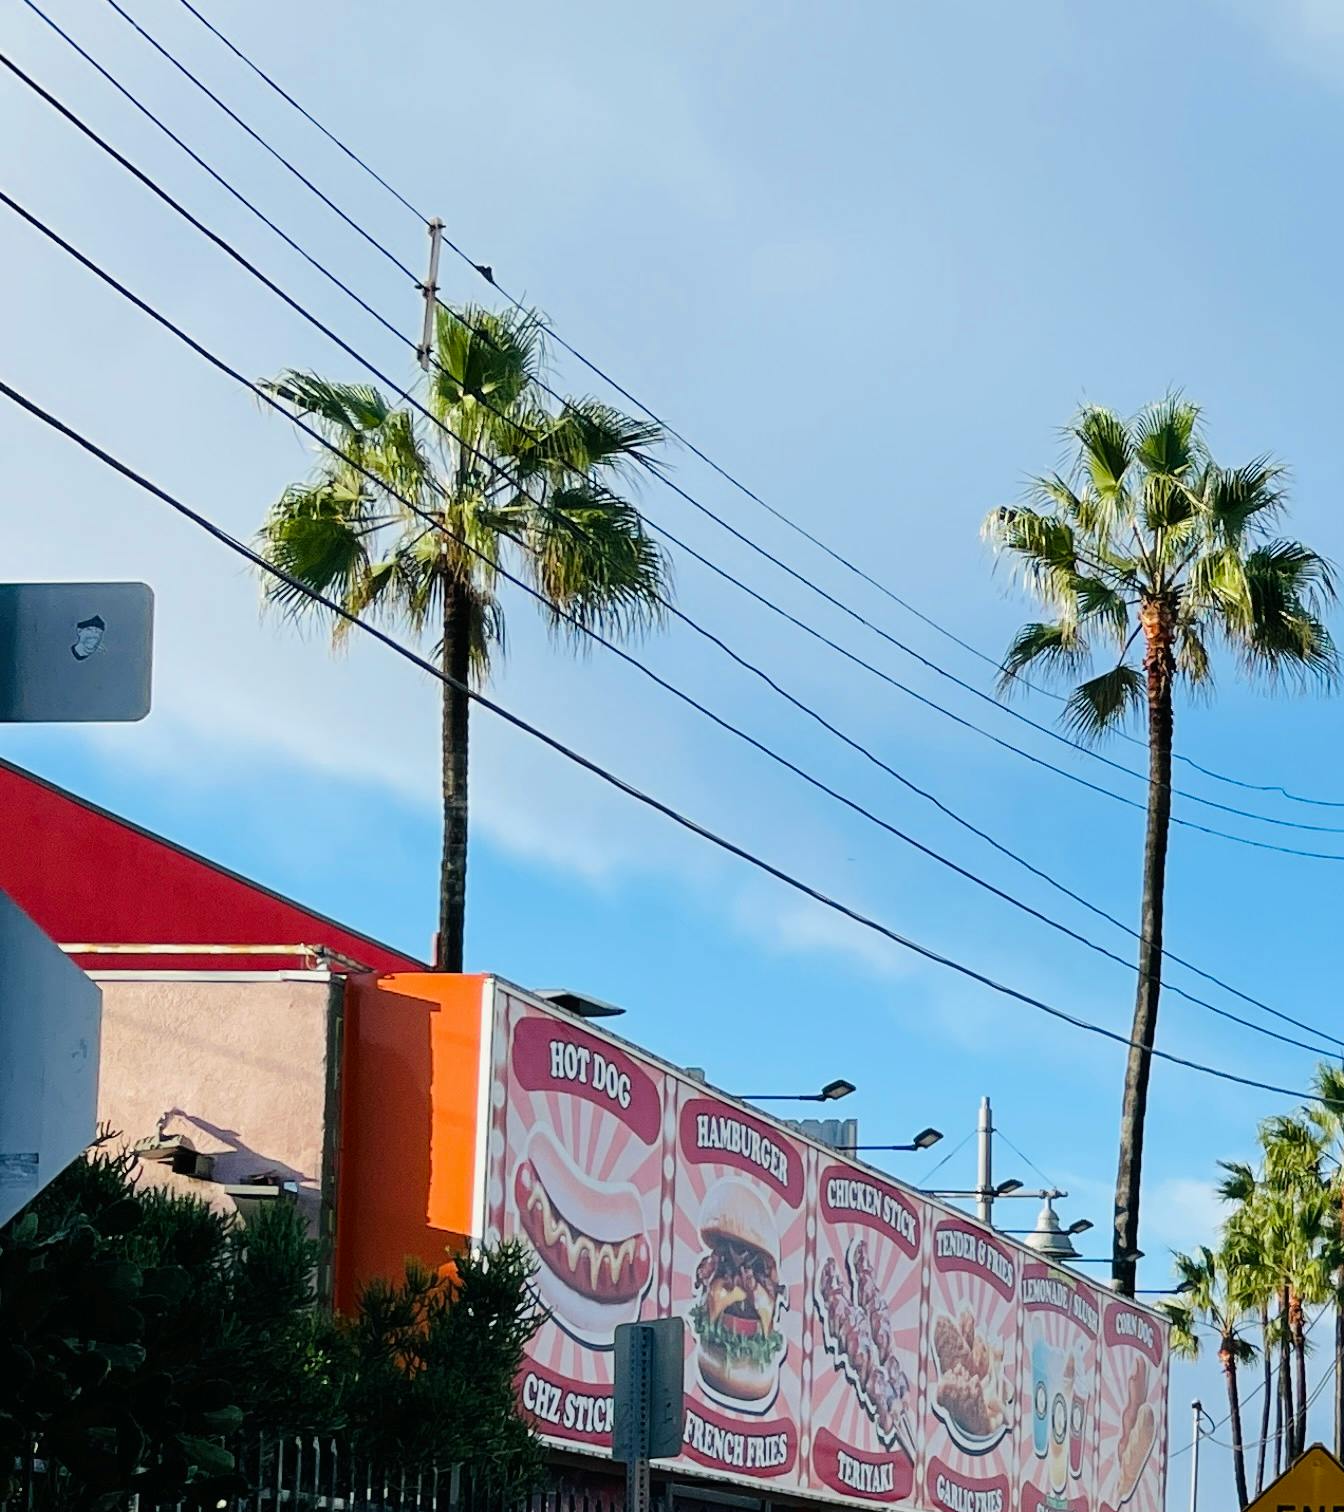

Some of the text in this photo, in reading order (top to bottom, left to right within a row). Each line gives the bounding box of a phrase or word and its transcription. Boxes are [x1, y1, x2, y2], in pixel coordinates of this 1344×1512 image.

[549, 1040, 632, 1110] HOT DOG
[696, 1113, 789, 1187] HAMBURGER
[826, 1178, 917, 1248] CHICKEN STICK
[935, 1229, 977, 1263] TENDER
[986, 1243, 1014, 1289] FRIES
[522, 1372, 563, 1425] CHZ
[682, 1409, 788, 1468] FRENCH FRIES
[837, 1449, 895, 1493] TERIYAKI
